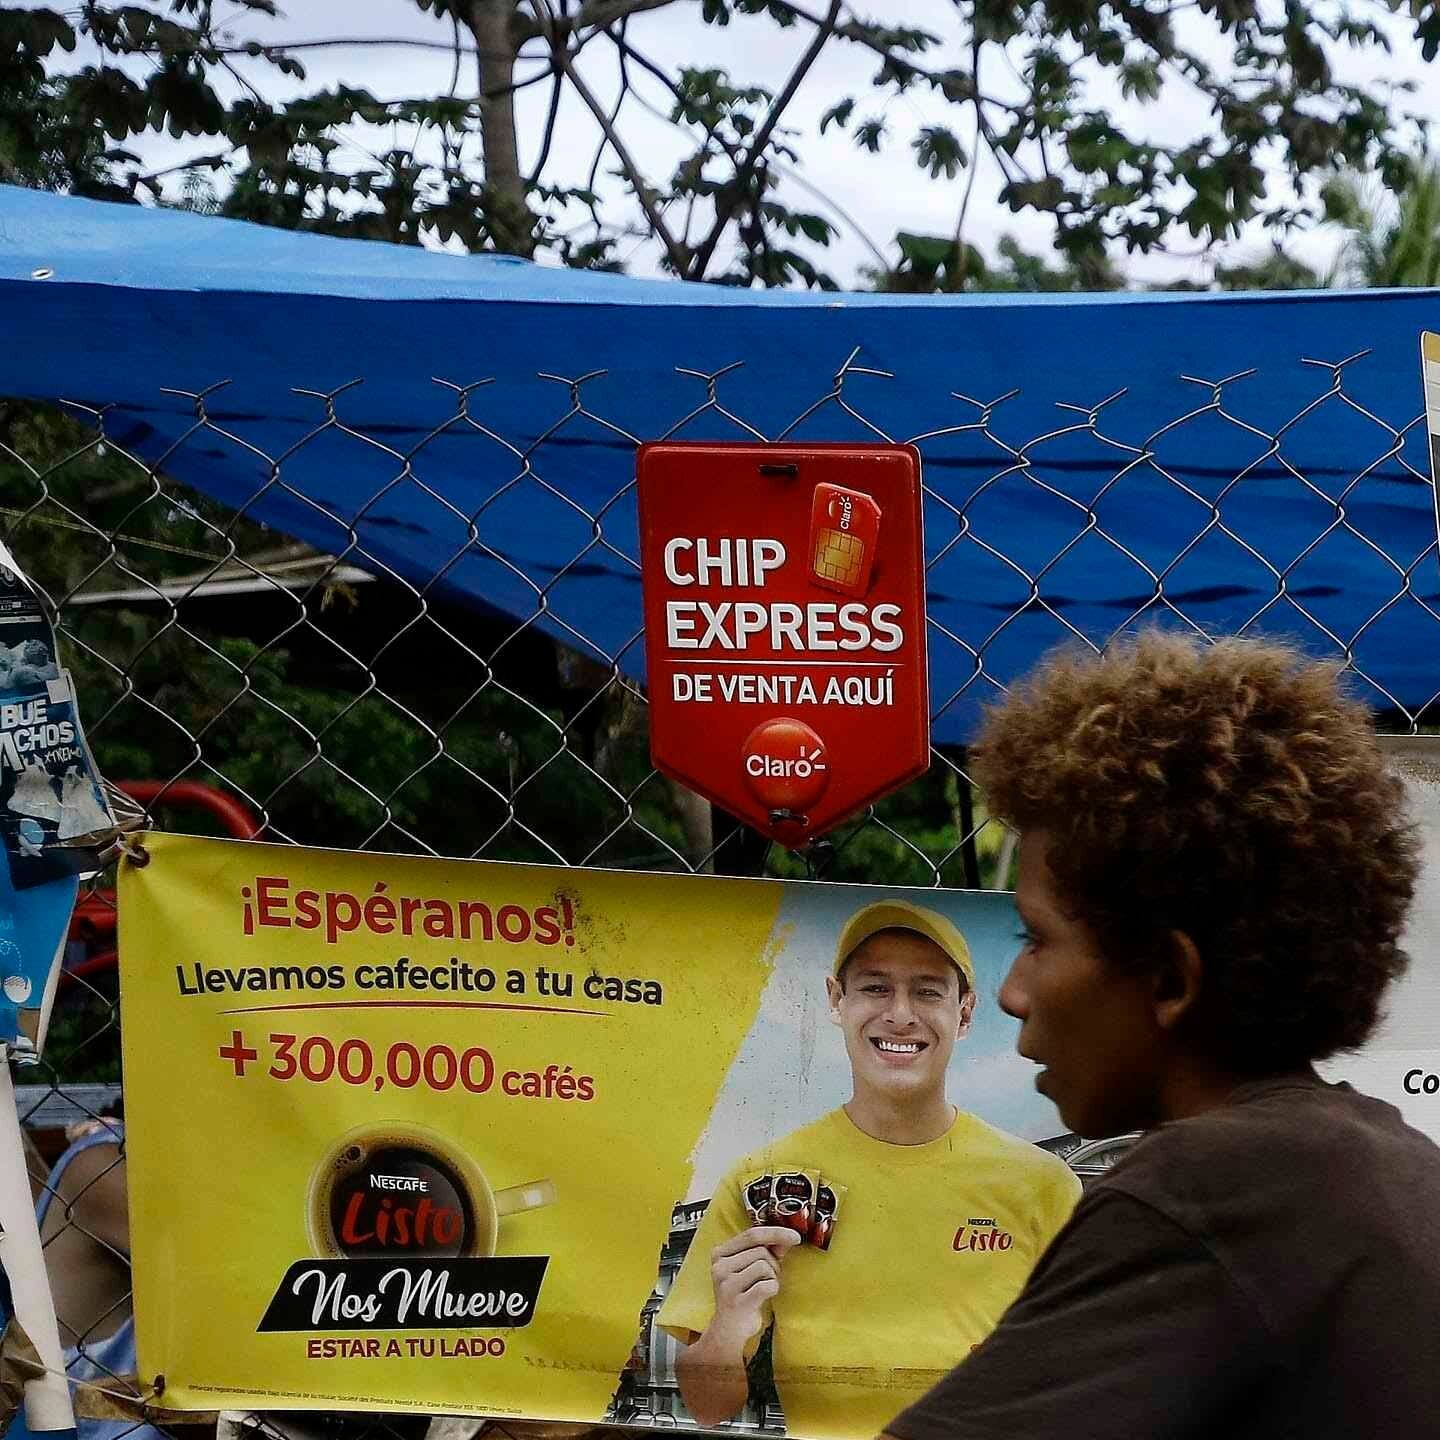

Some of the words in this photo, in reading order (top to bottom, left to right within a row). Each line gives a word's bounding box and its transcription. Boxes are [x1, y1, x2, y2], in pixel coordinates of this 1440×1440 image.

[664, 538, 786, 588] CHIP
[665, 601, 904, 652] EXPRESS
[672, 674, 713, 703] DE
[715, 673, 820, 706] VENTA
[822, 668, 895, 706] AQUÍ
[745, 745, 826, 779] Claro
[241, 877, 576, 947] ¡Espéranos!
[176, 963, 346, 996] Llevamos
[355, 961, 496, 996] cafecito
[505, 973, 528, 995] a
[535, 967, 575, 998] tu
[583, 975, 664, 1005] casa
[219, 1031, 258, 1077] +
[269, 1032, 495, 1094] 300,000
[501, 1064, 595, 1102] cafés
[342, 1193, 461, 1247] Listo
[952, 1225, 1012, 1252] Listo
[292, 1269, 382, 1325] Nos
[378, 1268, 529, 1323] Mueve
[307, 1338, 380, 1359] ESTAR
[384, 1339, 401, 1358] A
[406, 1338, 436, 1357] TU
[440, 1337, 505, 1357] LADO
